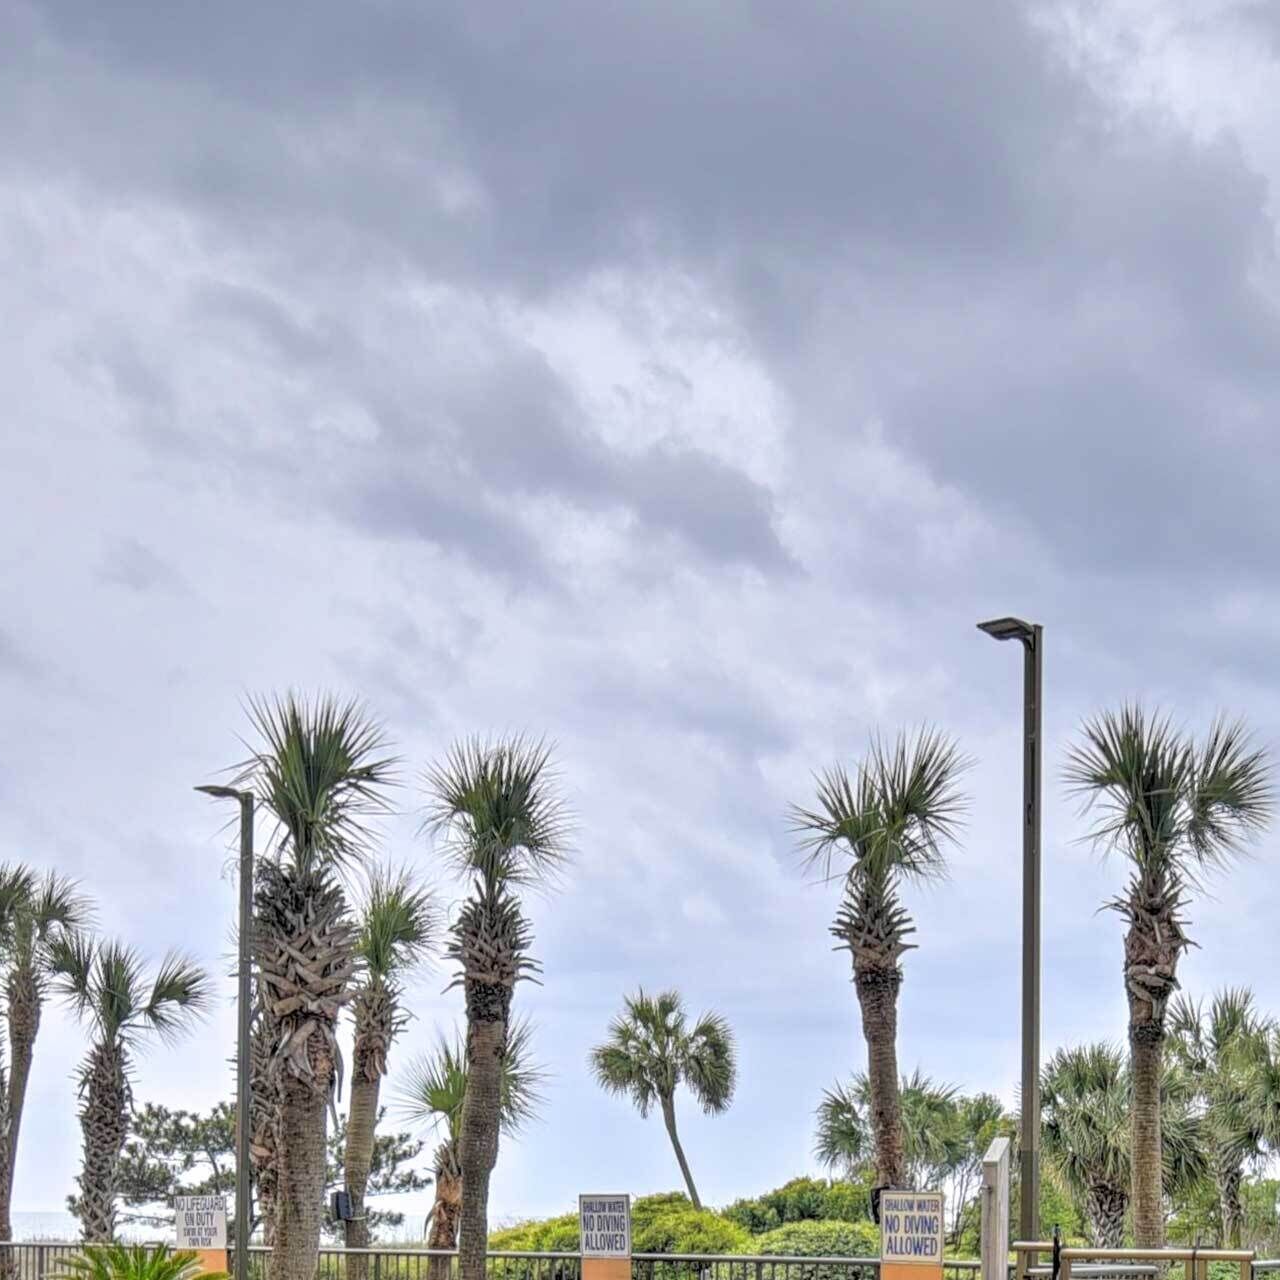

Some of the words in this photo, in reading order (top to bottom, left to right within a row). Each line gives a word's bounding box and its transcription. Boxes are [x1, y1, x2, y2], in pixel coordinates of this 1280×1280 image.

[176, 1197, 184, 1211] NO
[186, 1197, 224, 1211] LIFEGUARD
[583, 1201, 607, 1212] SHALLOW
[885, 1199, 914, 1211] SHALLOW
[917, 1200, 939, 1212] WATER
[185, 1212, 194, 1226] ON
[196, 1212, 214, 1226] DUTY
[583, 1215, 594, 1232] NO
[597, 1215, 625, 1232] DIVING
[885, 1215, 899, 1234] NO
[904, 1215, 939, 1234] DIVING
[585, 1233, 625, 1250] ALLOWED
[887, 1236, 938, 1256] ALLOWED
